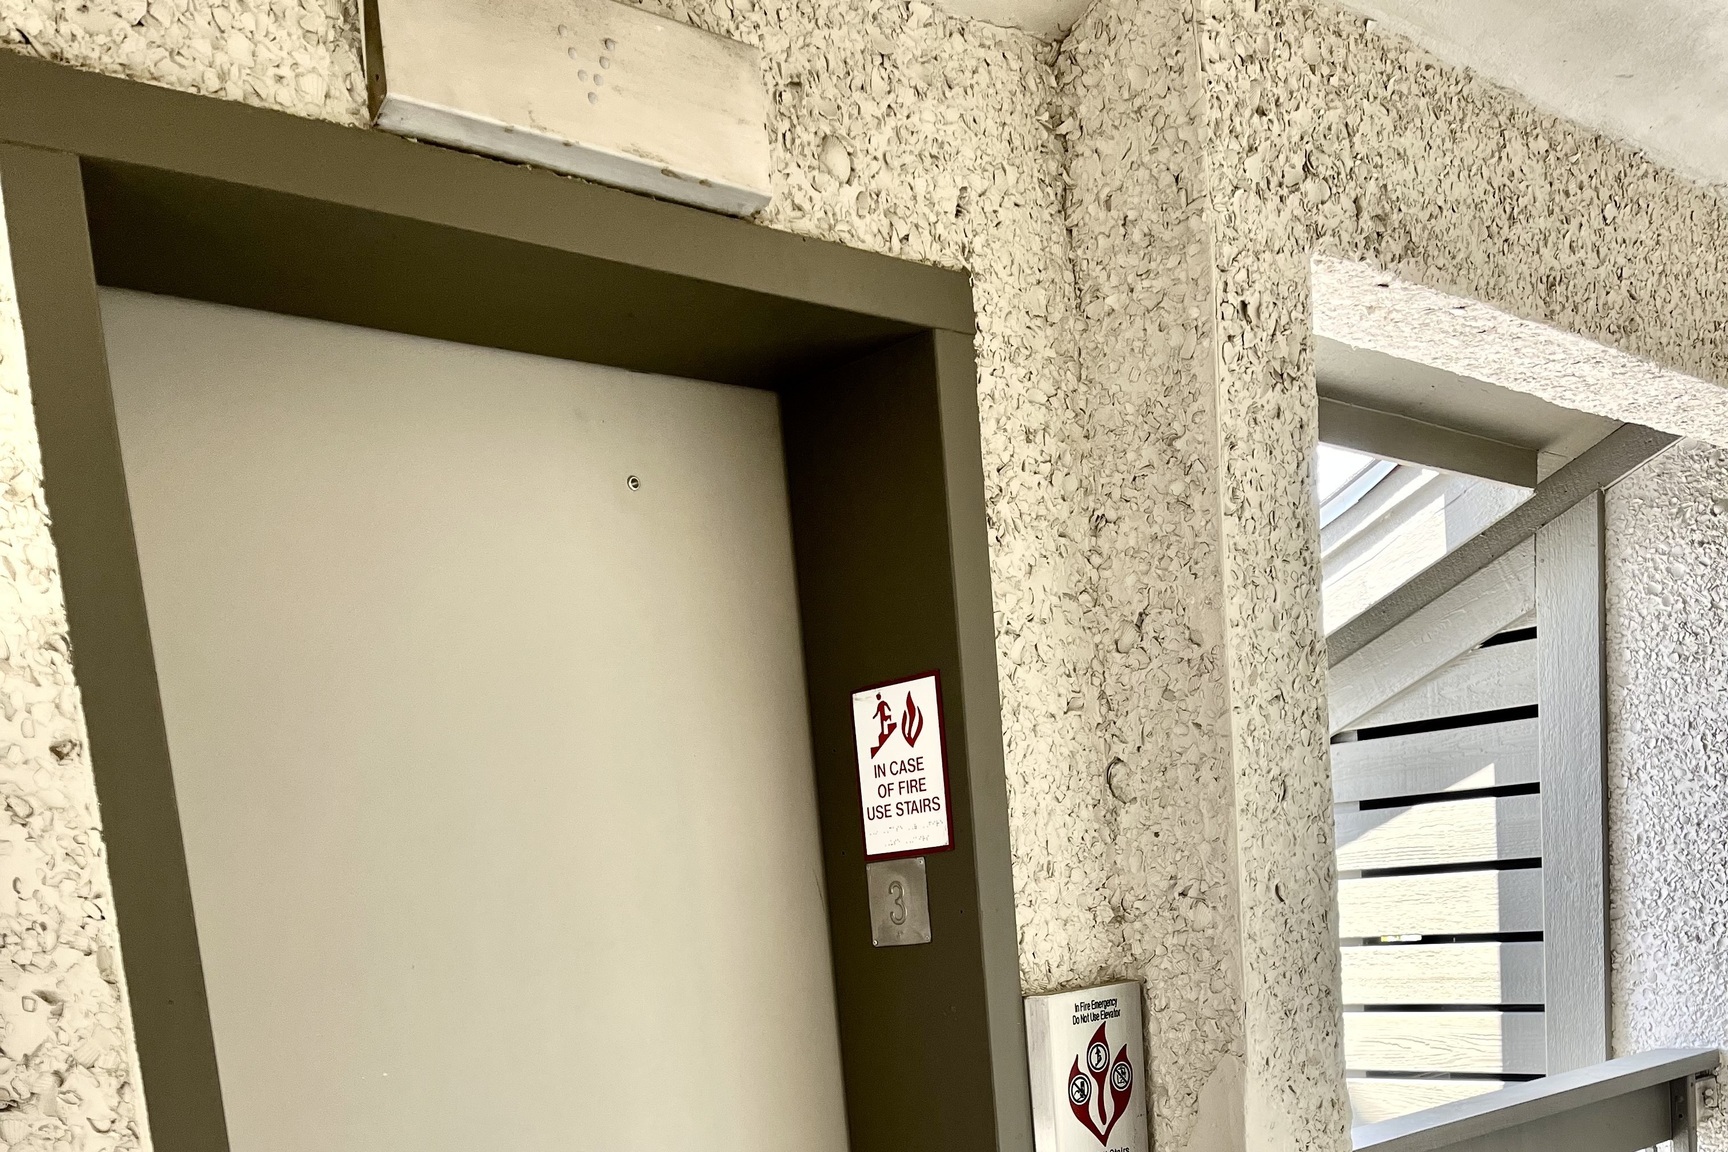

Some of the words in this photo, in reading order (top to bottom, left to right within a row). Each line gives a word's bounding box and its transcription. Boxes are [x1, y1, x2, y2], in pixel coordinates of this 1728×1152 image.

[874, 763, 886, 778] IN
[889, 756, 925, 776] CASE
[877, 782, 895, 798] OF
[898, 777, 927, 796] FIRE
[866, 803, 893, 821] USE
[895, 796, 941, 817] STAIRS
[888, 880, 908, 926] 3
[1074, 1003, 1080, 1013] In
[1080, 1001, 1090, 1011] Fire
[1091, 998, 1118, 1010] Emergency
[1072, 1014, 1080, 1025] Do
[1080, 1013, 1090, 1023] Not
[1090, 1011, 1100, 1022] Use
[1100, 1008, 1121, 1020] Elevator
